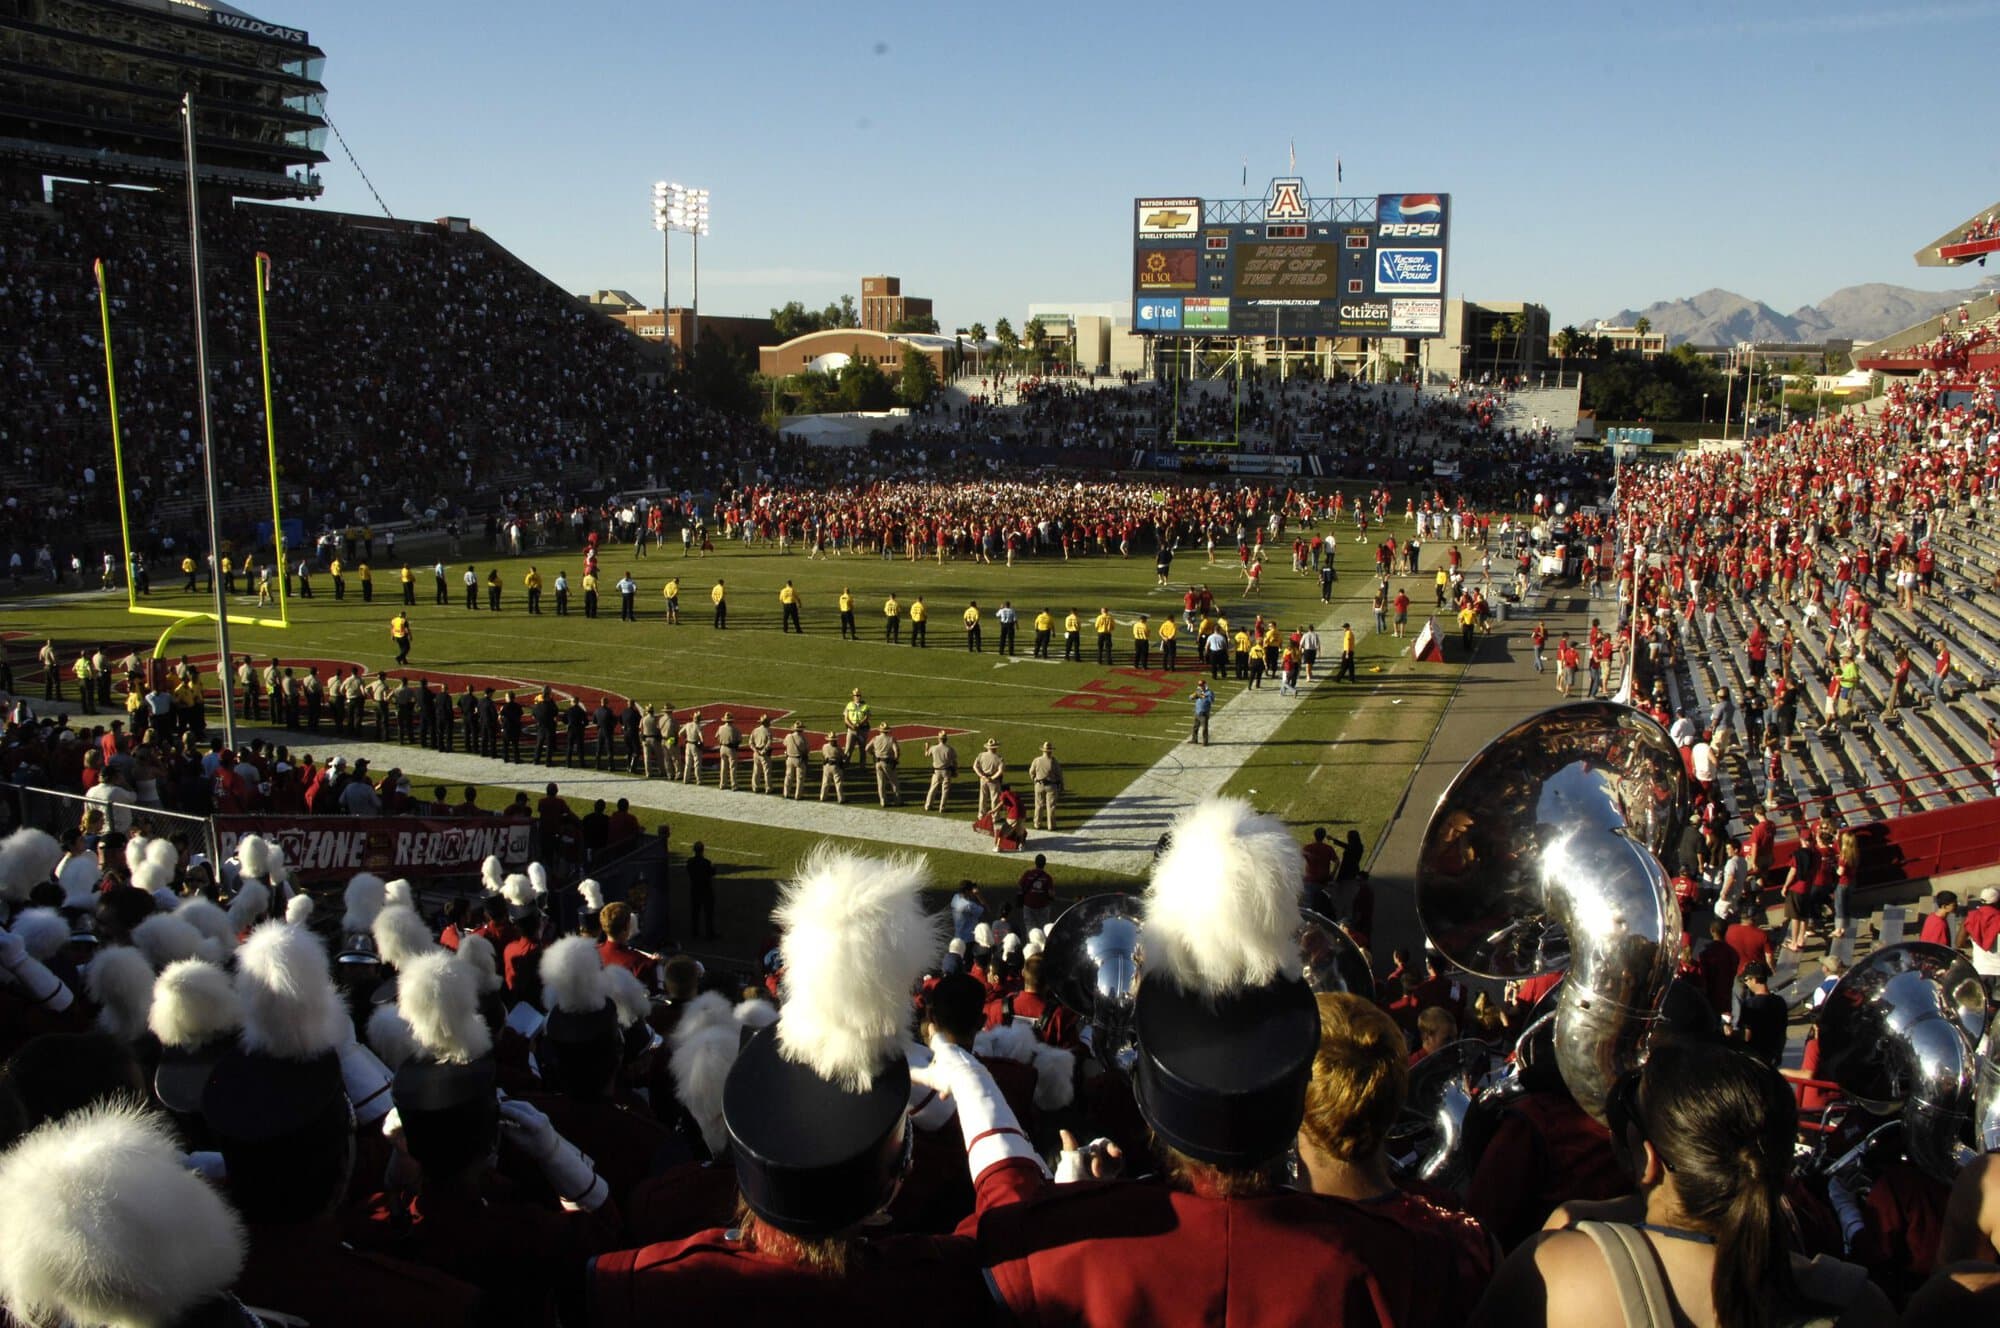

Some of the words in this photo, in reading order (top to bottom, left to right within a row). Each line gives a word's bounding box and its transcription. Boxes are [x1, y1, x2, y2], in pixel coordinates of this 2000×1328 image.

[215, 12, 305, 42] WILDCATS
[1164, 199, 1197, 207] CHEVROLET
[1266, 182, 1310, 221] A
[1378, 223, 1441, 237] PEPSI
[1256, 245, 1317, 257] PLEASE
[1244, 259, 1286, 271] STAY
[1288, 259, 1326, 271] OFF
[1393, 254, 1425, 264] Tucson
[1396, 263, 1432, 272] Electric
[1140, 272, 1155, 282] DEL
[1157, 272, 1171, 282] SOL
[1242, 273, 1275, 285] THE
[1279, 273, 1328, 285] FIELD
[1400, 271, 1432, 280] Power
[1141, 305, 1177, 320] altel
[1340, 305, 1389, 319] Citizen
[303, 831, 367, 868] ZONE
[395, 831, 442, 865] RED
[461, 827, 509, 862] ZONE
